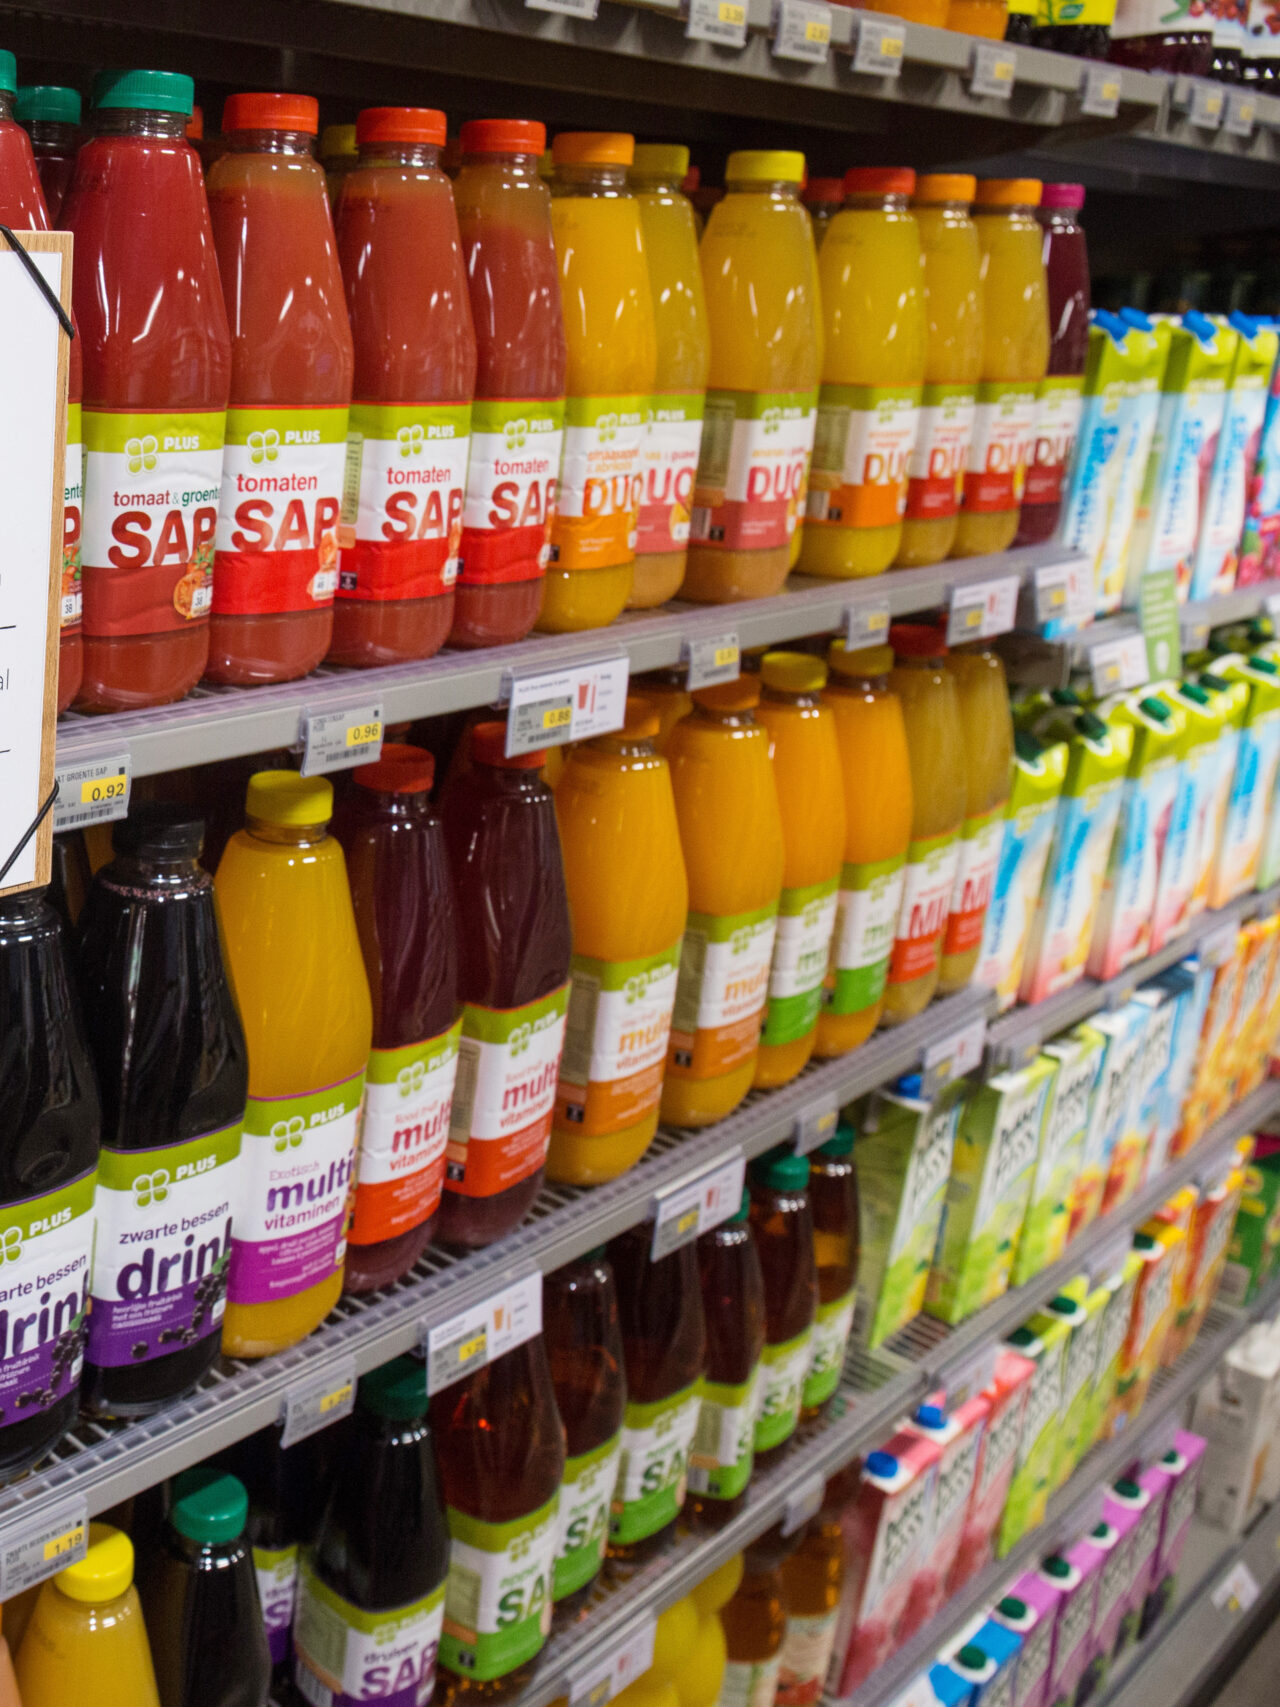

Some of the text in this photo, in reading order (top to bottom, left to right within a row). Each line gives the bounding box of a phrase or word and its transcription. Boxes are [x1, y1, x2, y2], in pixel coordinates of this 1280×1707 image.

[428, 425, 455, 438] PLUS
[530, 419, 553, 431] PLUS
[164, 436, 199, 450] PLUS
[285, 430, 320, 444] PLUS
[387, 466, 451, 485] tomaten
[493, 458, 549, 476] tomaten
[237, 473, 318, 493] tomaten
[114, 489, 170, 507] tomaat
[231, 496, 339, 552] SAP
[381, 488, 463, 542] SAP
[108, 506, 218, 569] SAP
[353, 723, 379, 740] 0,96
[91, 782, 124, 801] 0,92
[310, 1103, 345, 1127] PLUS
[176, 1154, 217, 1180] PLUS
[266, 1149, 355, 1213] multi
[29, 1207, 72, 1237] PLUS
[119, 1201, 229, 1245] zwarte bessen
[264, 1195, 340, 1231] vitaminen
[37, 1254, 87, 1290] bessen
